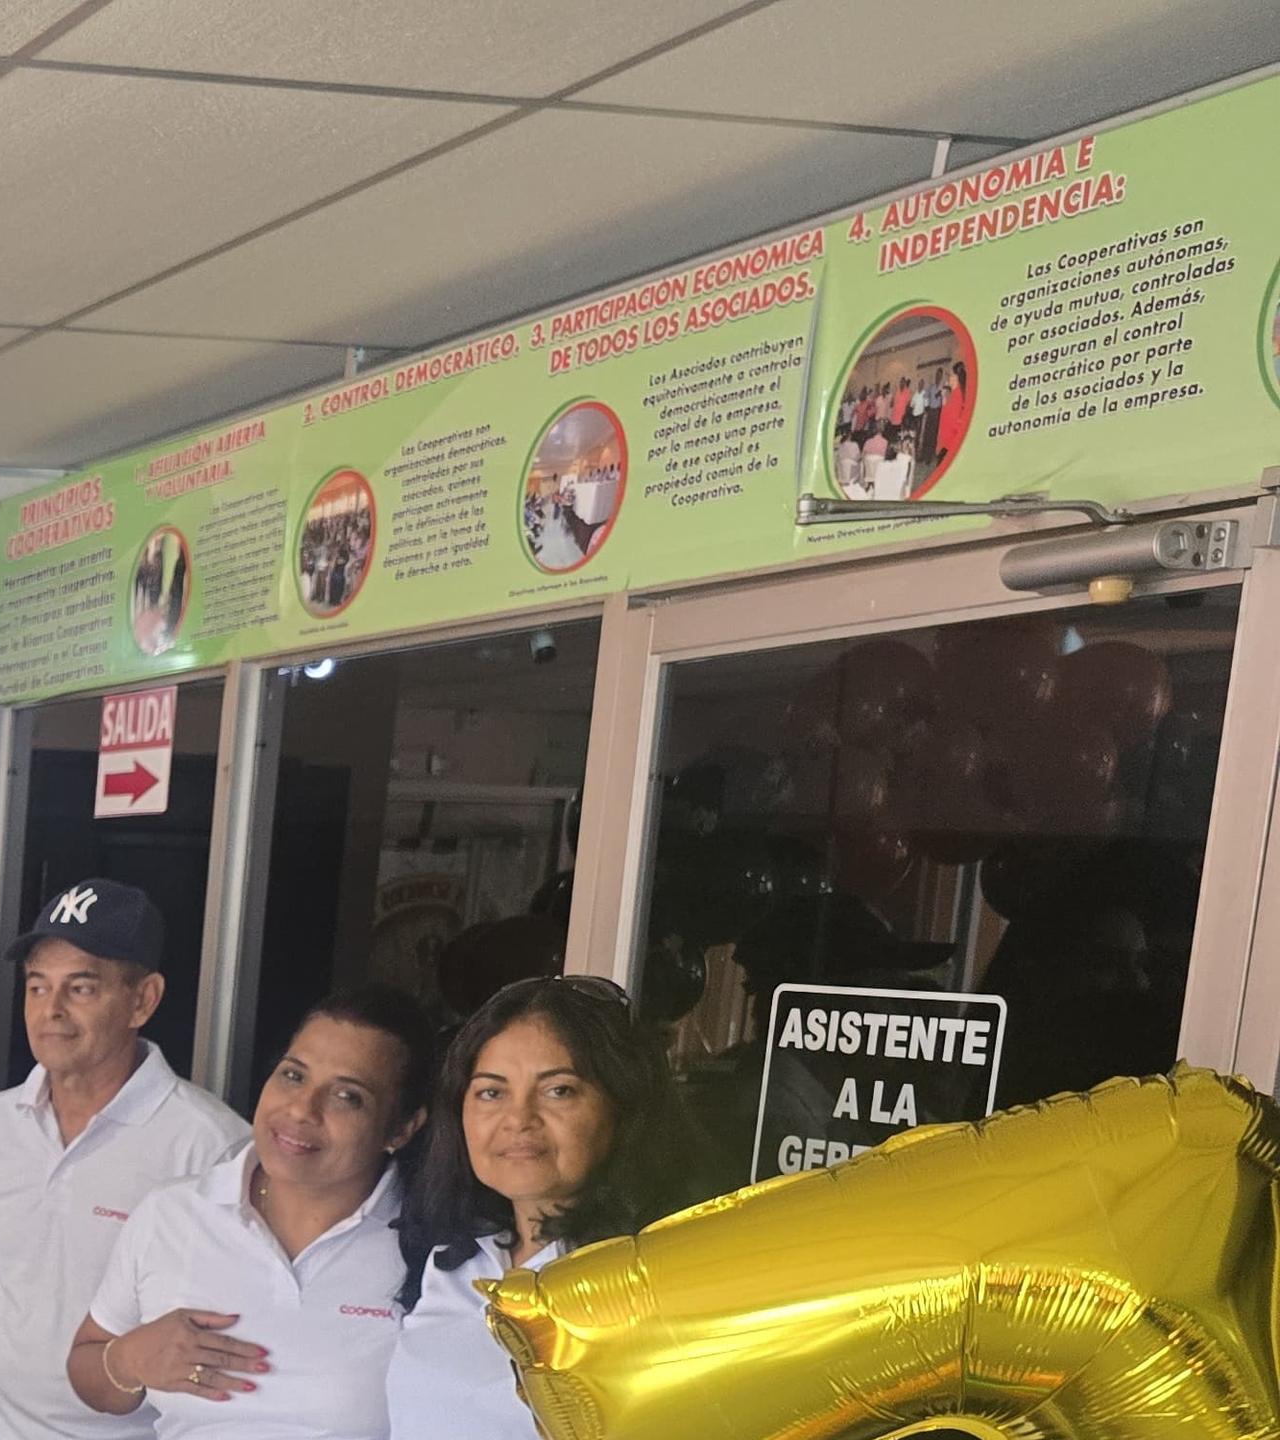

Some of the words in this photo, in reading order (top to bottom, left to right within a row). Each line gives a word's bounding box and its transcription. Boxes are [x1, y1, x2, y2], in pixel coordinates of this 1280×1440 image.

[848, 211, 871, 241] 4.
[1077, 136, 1096, 169] E
[879, 173, 1127, 272] INDEPENDENCIA:
[1000, 264, 1121, 308] organizaciones
[1126, 236, 1229, 274] autónomas,
[1027, 263, 1052, 279] Las
[1058, 228, 1168, 270] Cooperativas
[1173, 219, 1204, 239] son
[990, 315, 1008, 332] de
[1014, 301, 1063, 328] ayuda
[1068, 287, 1125, 312] mutua,
[1132, 257, 1236, 295] controladas
[1007, 332, 1035, 353] por
[1040, 311, 1125, 341] asociados.
[1131, 287, 1206, 319] Además,
[531, 324, 546, 347] 3.
[550, 349, 572, 373] DE
[576, 325, 639, 363] TODOS
[643, 312, 680, 343] LOS
[685, 271, 815, 332] ASOCIADOS.
[1023, 339, 1097, 366] aseguran
[1103, 328, 1119, 347] el
[1123, 312, 1184, 342] control
[649, 374, 666, 387] Los
[670, 356, 726, 381] Asociados
[730, 335, 804, 365] contribuyen
[769, 375, 782, 392] el
[1009, 359, 1105, 391] democrático
[1110, 350, 1141, 373] por
[1145, 337, 1193, 365] parte
[1011, 395, 1030, 412] de
[1035, 391, 1057, 408] los
[1063, 371, 1145, 400] asociados
[1151, 367, 1162, 387] y
[1167, 360, 1184, 377] la
[320, 376, 389, 417] CONTROL
[642, 373, 733, 407] equitativamente
[988, 408, 1071, 438] autonomía
[1077, 401, 1097, 419] de
[1102, 397, 1118, 414] la
[1124, 382, 1204, 411] empresa.
[647, 445, 667, 462] por
[670, 439, 681, 453] lo
[683, 432, 721, 449] menos
[724, 425, 746, 439] una
[750, 416, 785, 437] parte
[653, 422, 691, 441] capital
[694, 416, 708, 429] de
[712, 411, 722, 425] la
[644, 469, 703, 499] propiedad
[747, 457, 762, 472] de
[766, 453, 778, 467] la
[665, 459, 678, 473] de
[682, 455, 700, 466] ese
[704, 442, 743, 465] capital
[746, 441, 760, 452] es
[671, 484, 744, 507] Cooperativa.
[101, 694, 171, 747] SALIDA
[778, 1007, 991, 1067] ASISTENTE
[832, 1078, 859, 1121] A
[870, 1080, 918, 1127] LA
